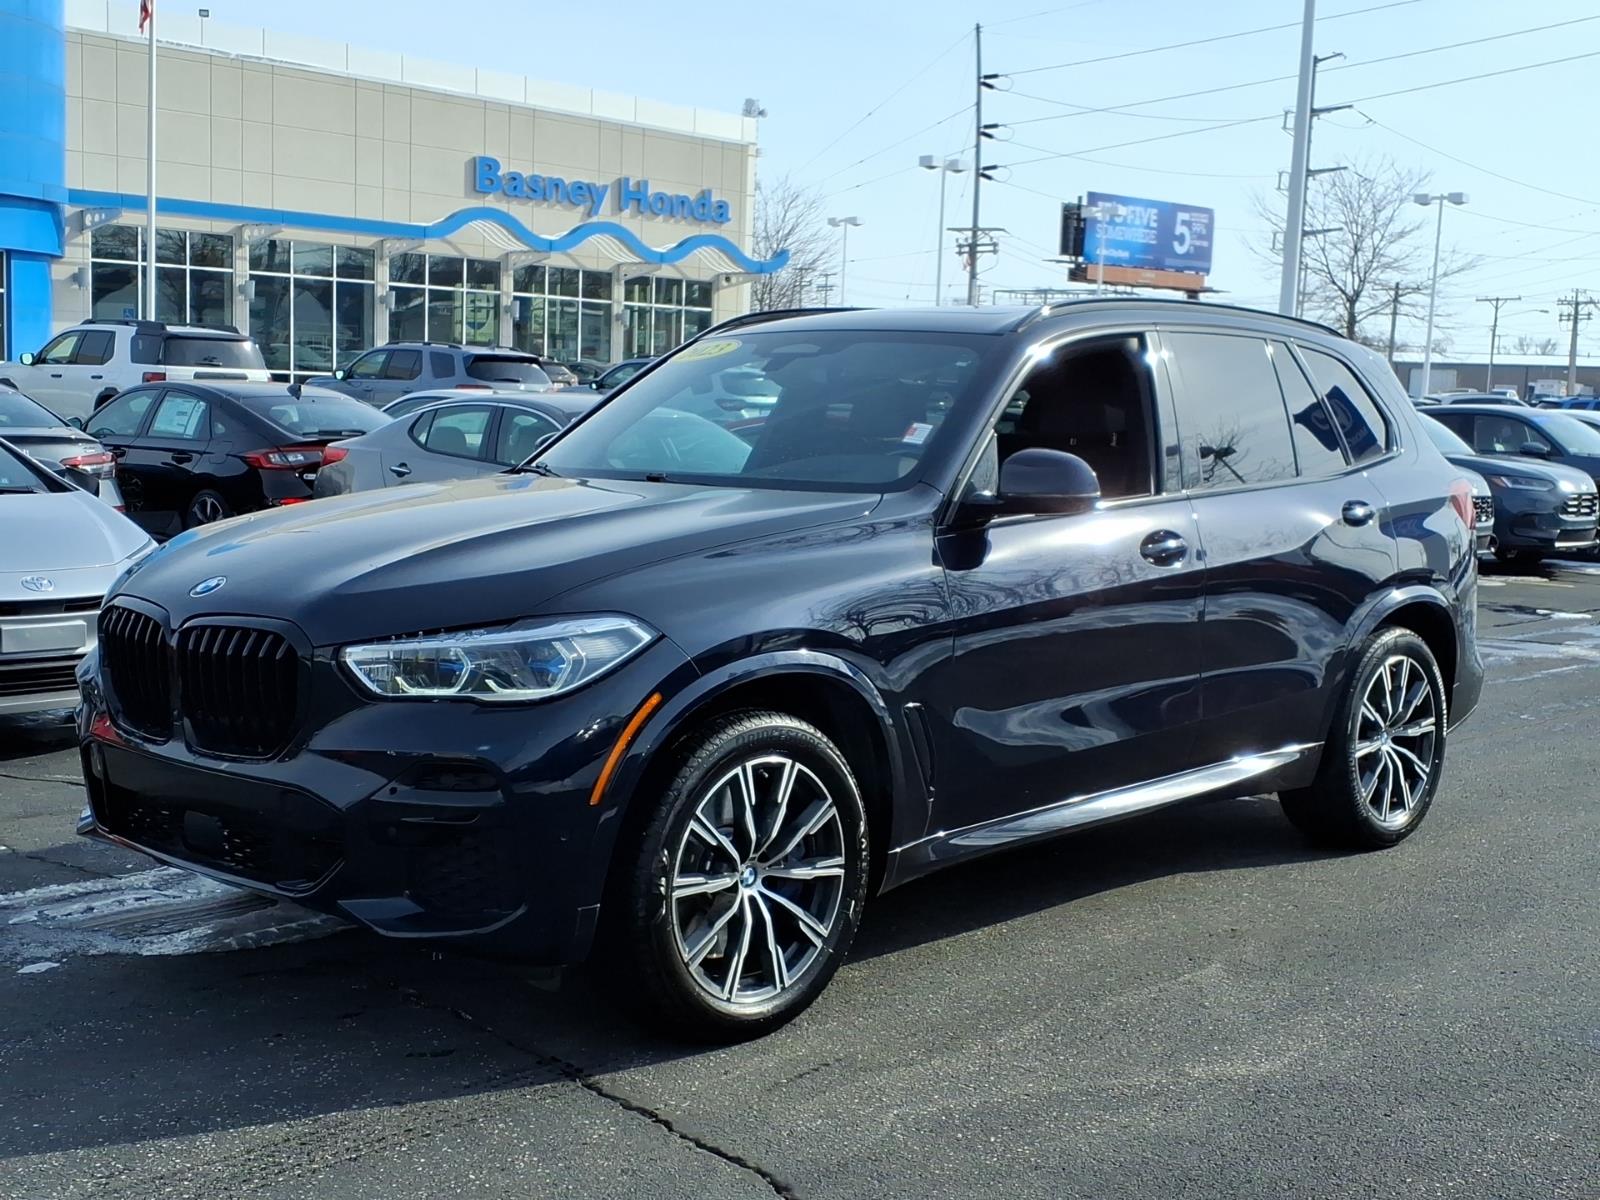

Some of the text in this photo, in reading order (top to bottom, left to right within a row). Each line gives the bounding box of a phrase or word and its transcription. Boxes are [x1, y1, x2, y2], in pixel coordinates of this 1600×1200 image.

[474, 155, 731, 224] Basney Honda
[1126, 205, 1158, 229] FIVE
[1173, 211, 1191, 255] 5
